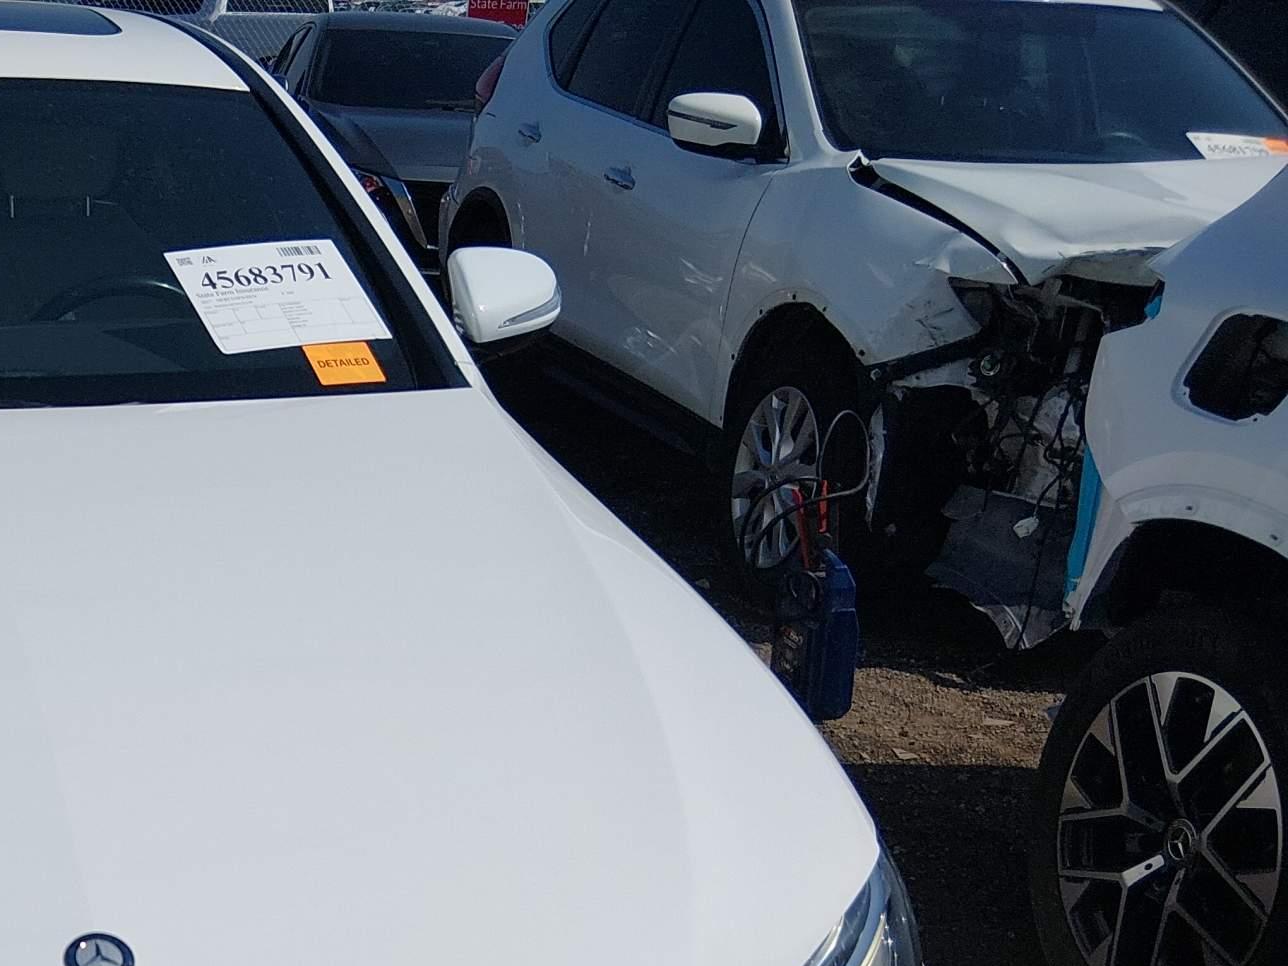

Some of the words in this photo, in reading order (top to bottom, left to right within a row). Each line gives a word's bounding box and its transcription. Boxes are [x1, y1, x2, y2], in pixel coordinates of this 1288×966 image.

[470, 0, 498, 9] State
[500, 0, 527, 9] Farm
[201, 262, 333, 290] 45683791
[317, 358, 370, 369] DETAILED
